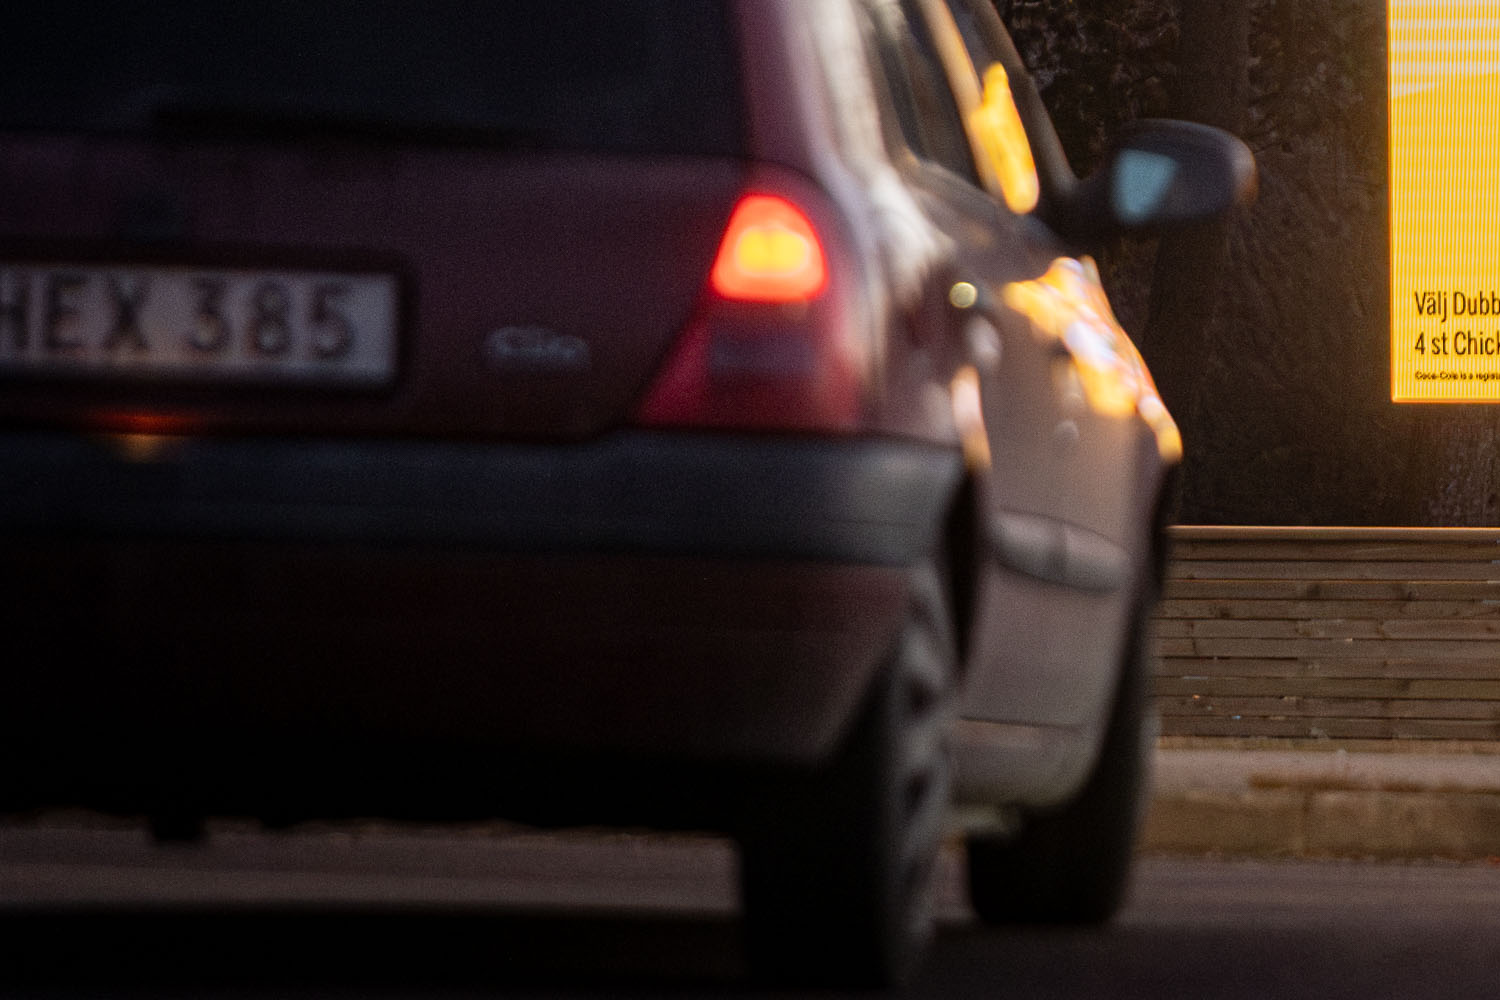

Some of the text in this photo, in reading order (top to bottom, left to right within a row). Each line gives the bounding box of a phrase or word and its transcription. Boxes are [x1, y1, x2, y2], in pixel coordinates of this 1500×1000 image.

[188, 277, 355, 360] 385
[1414, 291, 1447, 323] Välj
[1414, 331, 1426, 356] 4
[1431, 332, 1448, 356] st
